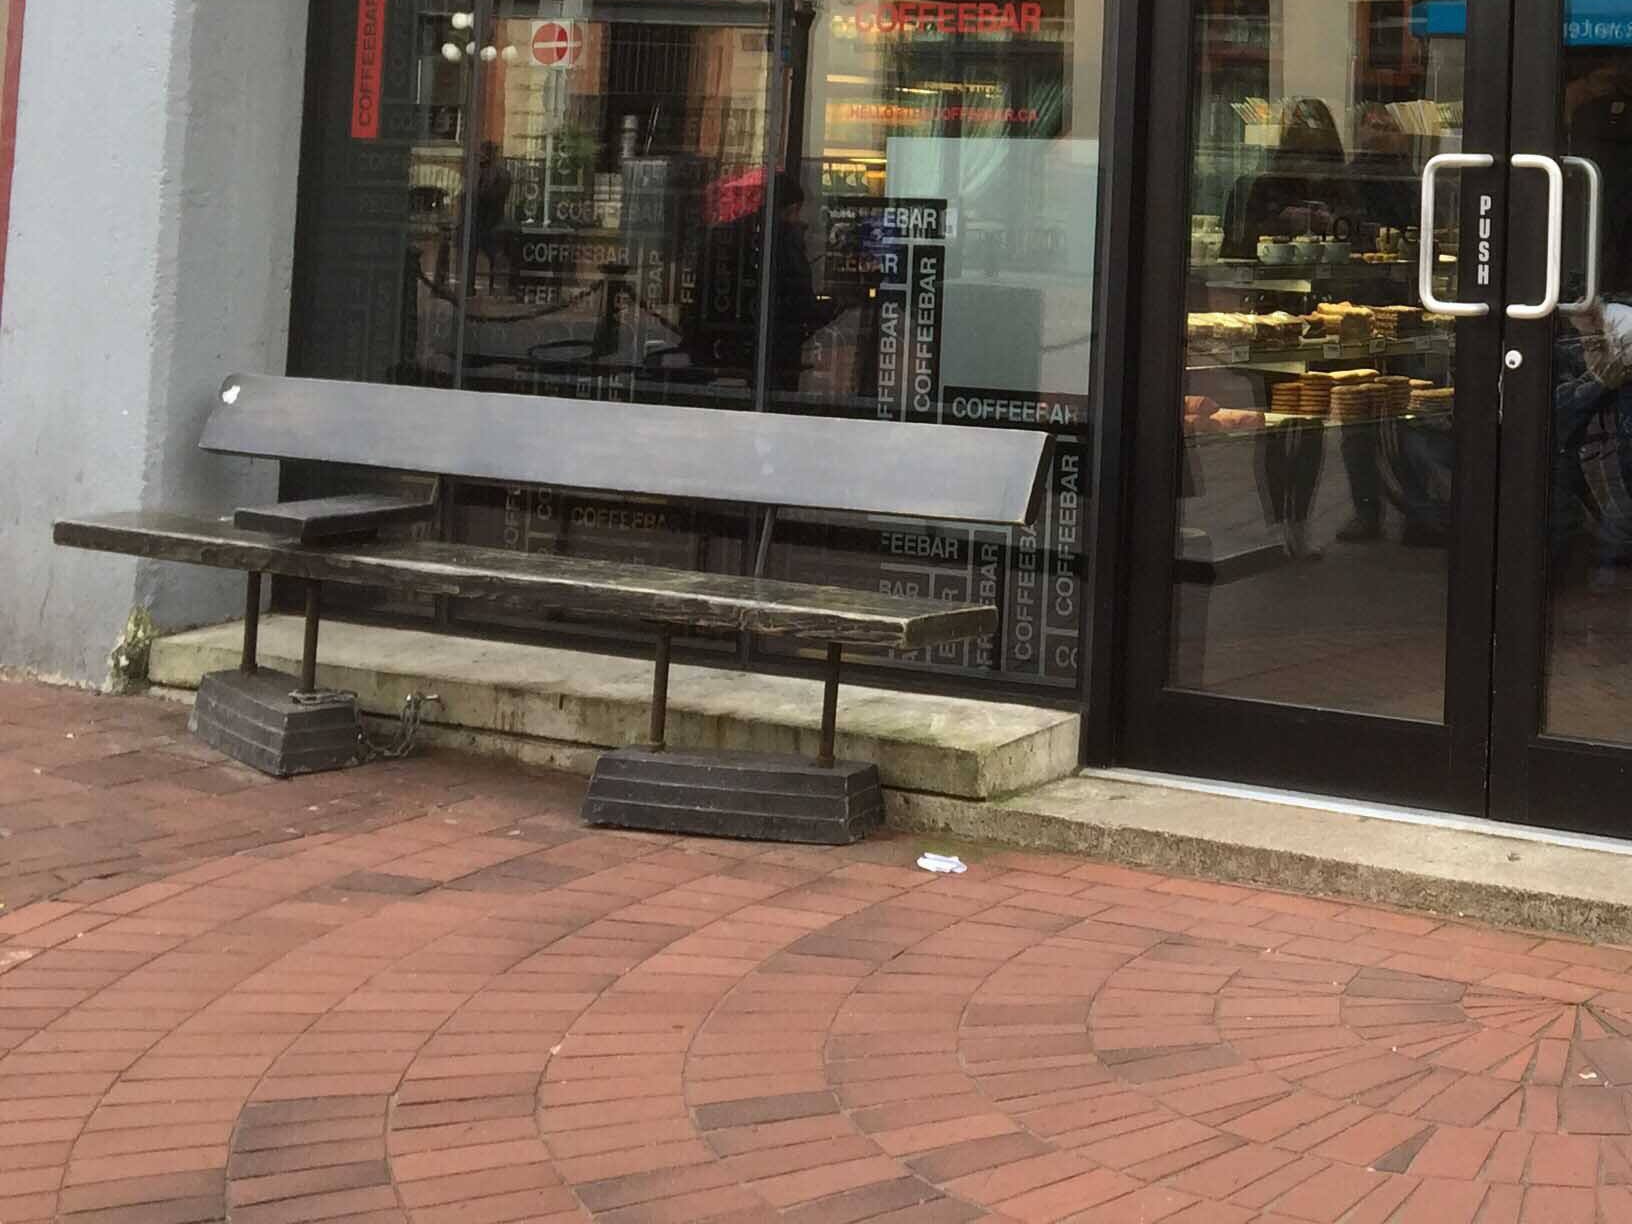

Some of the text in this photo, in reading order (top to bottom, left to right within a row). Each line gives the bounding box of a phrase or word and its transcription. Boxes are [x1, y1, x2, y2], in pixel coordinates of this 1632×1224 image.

[855, 1, 1042, 33] COFFEEBAR
[1476, 194, 1493, 286] PUSH
[912, 257, 938, 413] COFFEEBAR
[1055, 455, 1080, 617] COFFEEBAR
